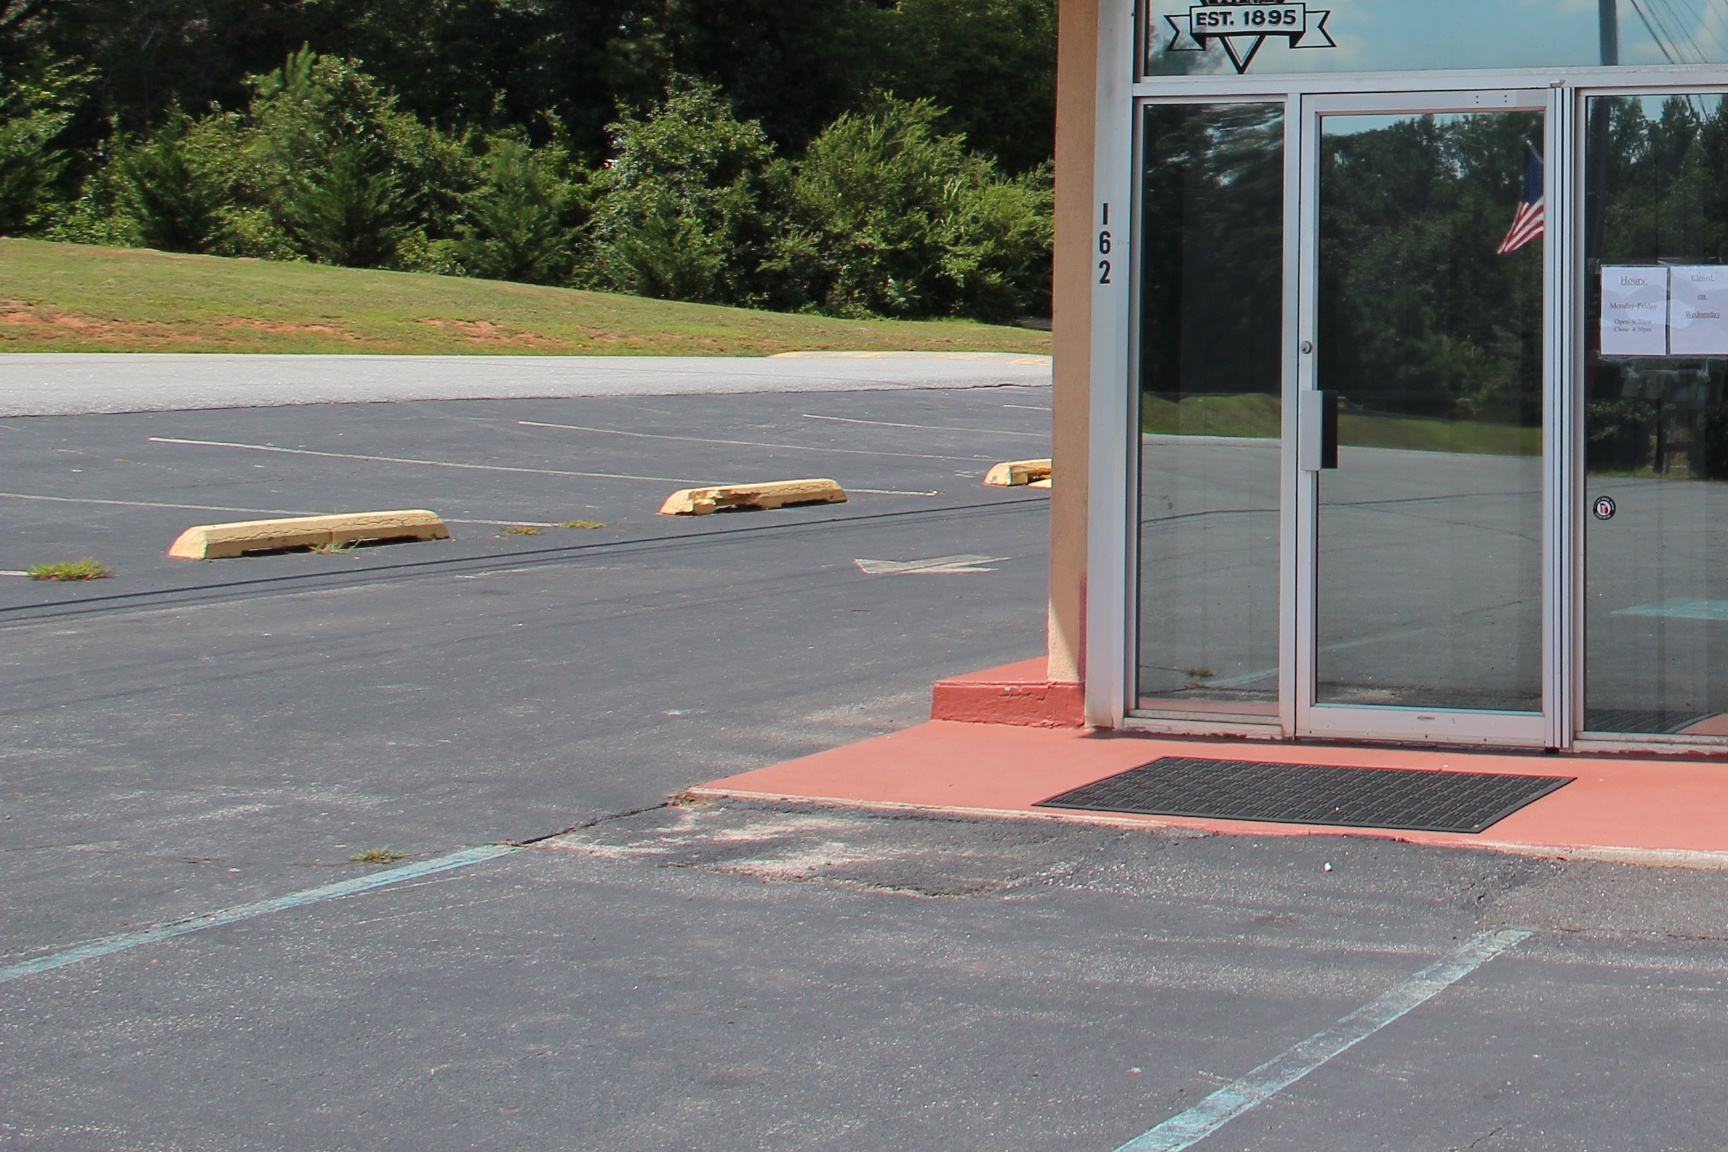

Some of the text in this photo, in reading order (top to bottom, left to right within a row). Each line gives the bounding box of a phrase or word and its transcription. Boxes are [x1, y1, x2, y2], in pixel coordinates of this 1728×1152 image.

[1196, 9, 1297, 27] EST. 1895
[1620, 275, 1648, 286] Hours:
[1685, 311, 1720, 319] Wednesday
